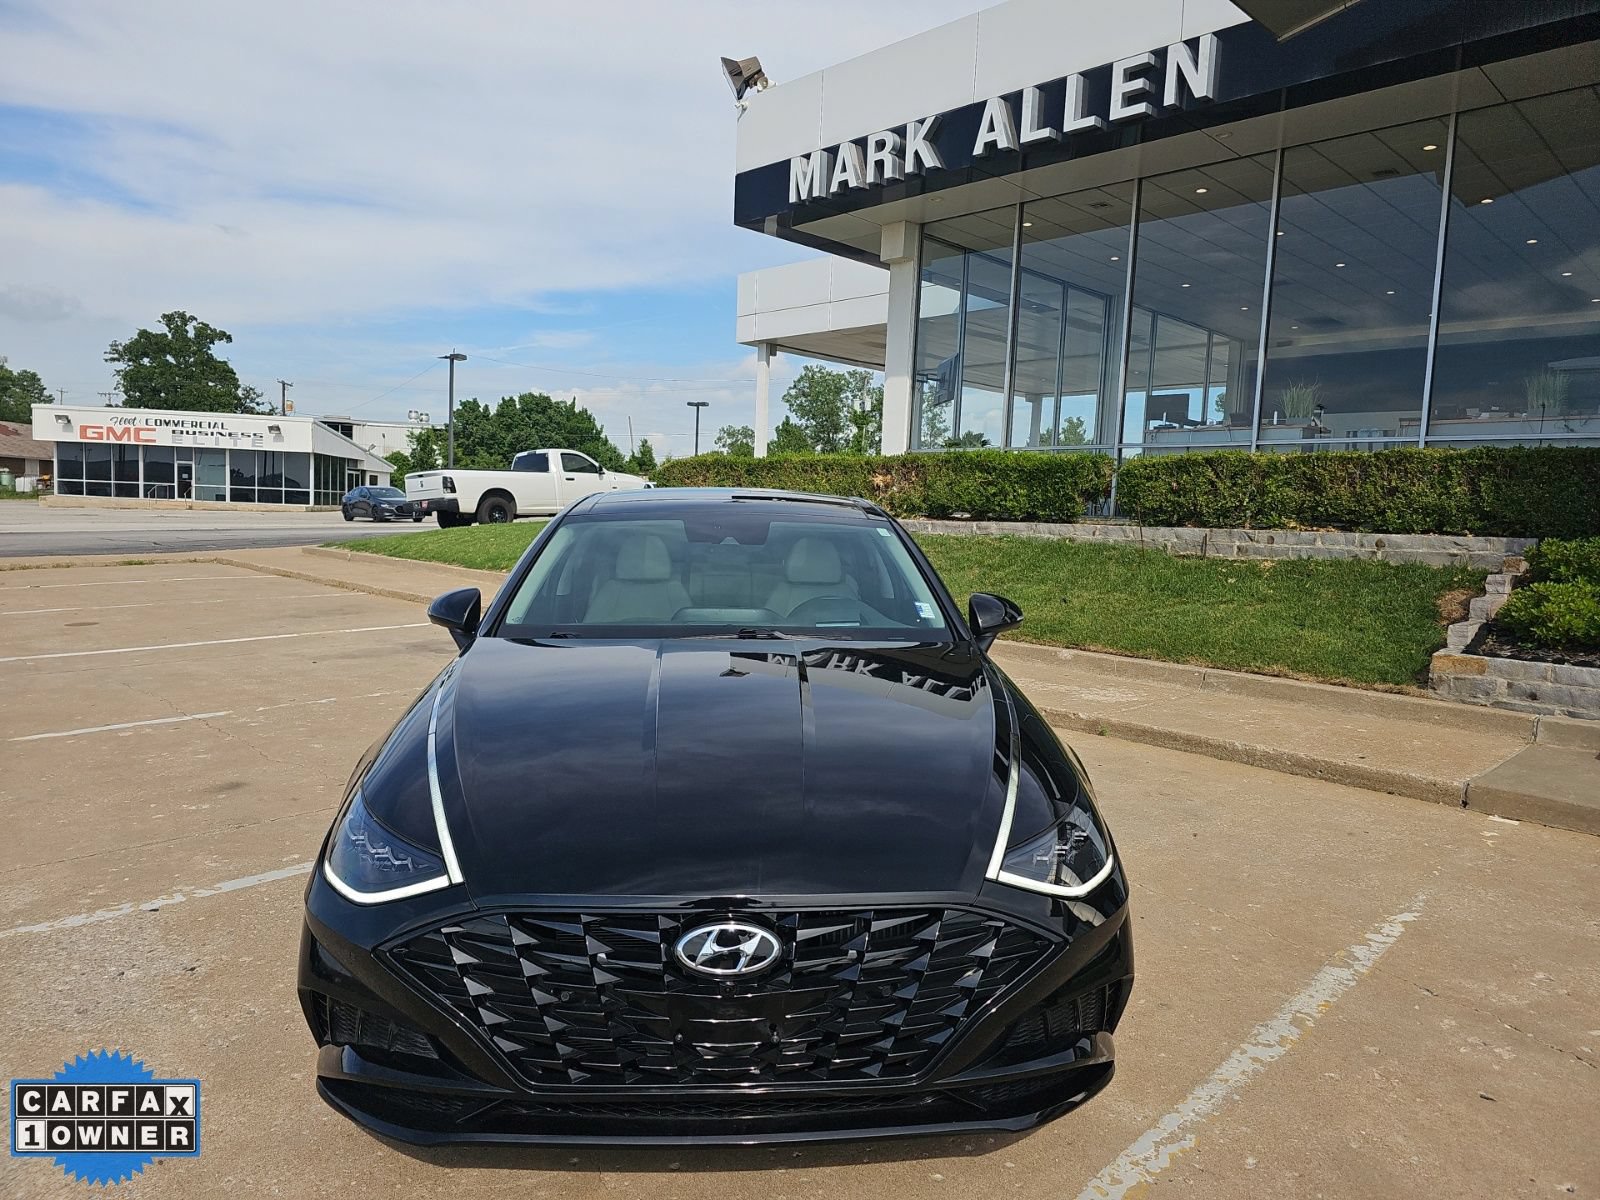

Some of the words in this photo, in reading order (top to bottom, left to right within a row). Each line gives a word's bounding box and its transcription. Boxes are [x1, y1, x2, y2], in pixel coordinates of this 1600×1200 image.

[788, 115, 943, 205] MARK
[973, 32, 1223, 157] ALLEN
[110, 416, 137, 426] Fleet
[145, 418, 229, 430] COMMERCIAL
[79, 424, 157, 443] GMC
[171, 429, 264, 438] BUSINESS
[171, 435, 264, 448] ELITE
